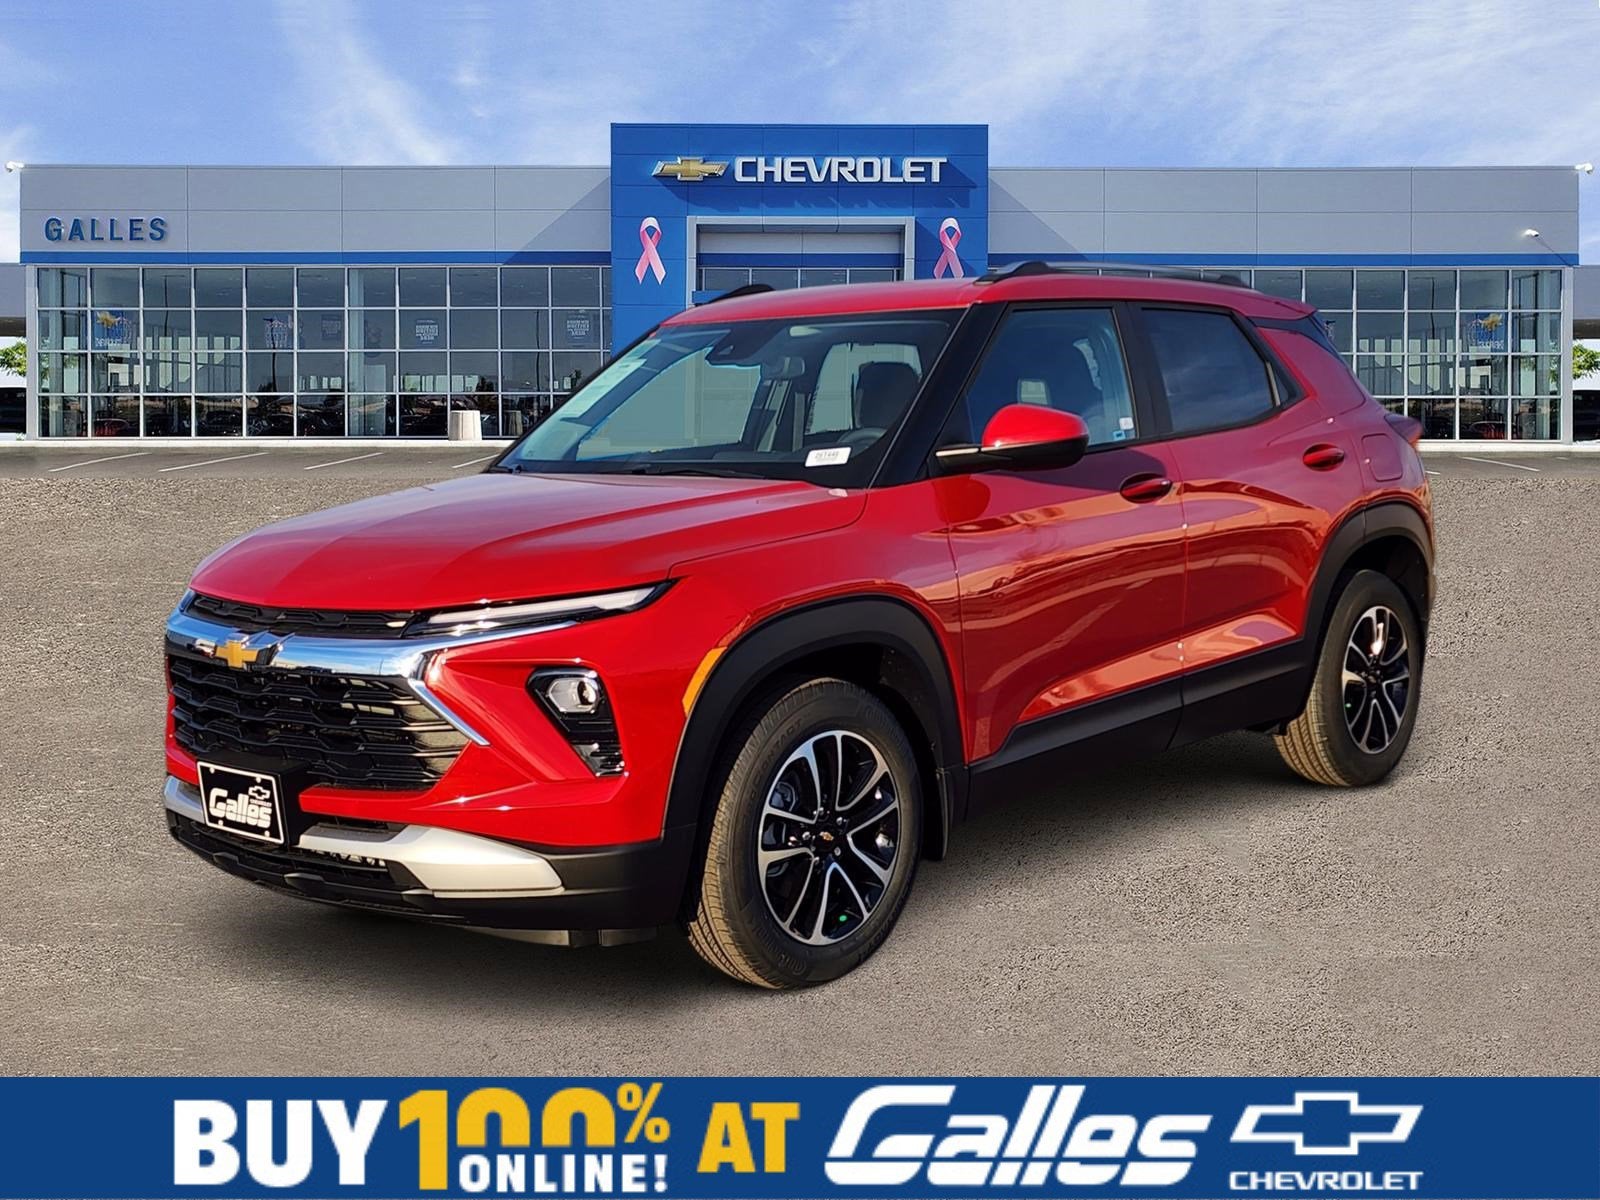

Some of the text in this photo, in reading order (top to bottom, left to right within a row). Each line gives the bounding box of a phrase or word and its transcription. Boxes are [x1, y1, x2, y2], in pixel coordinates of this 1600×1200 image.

[734, 156, 947, 182] CHEVROLET
[44, 217, 166, 241] GALLES
[209, 787, 272, 829] Galles
